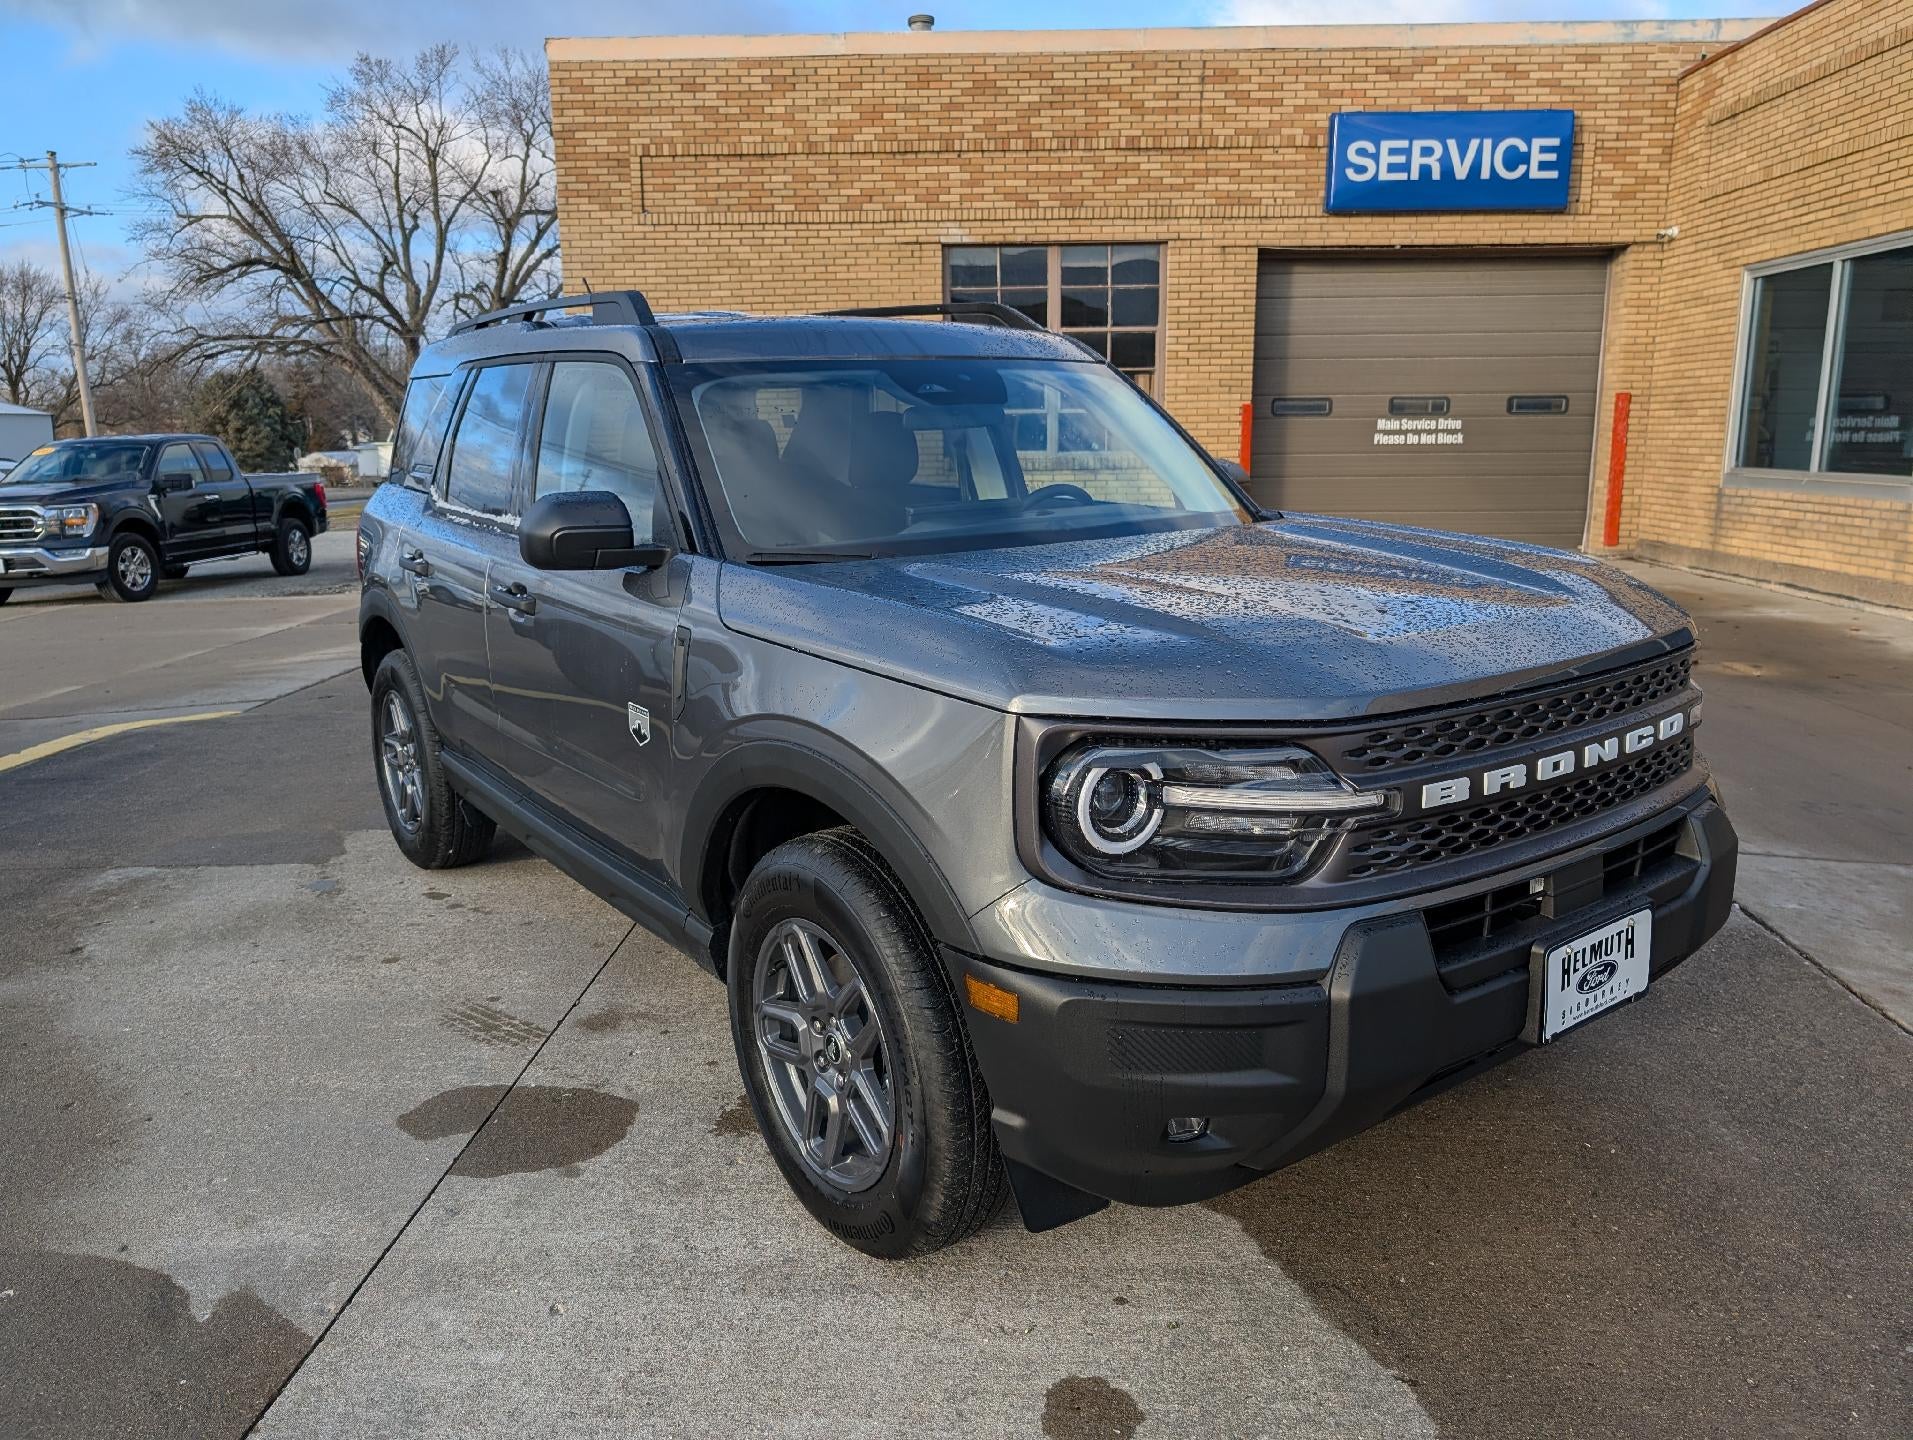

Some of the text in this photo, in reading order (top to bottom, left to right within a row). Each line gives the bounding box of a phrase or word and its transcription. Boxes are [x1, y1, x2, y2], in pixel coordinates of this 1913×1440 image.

[1345, 137, 1560, 182] SERVICE
[1374, 432, 1464, 445] Please Do Not Block
[1377, 418, 1462, 430] Main Service Drive
[1422, 712, 1684, 809] BRONCO
[1561, 926, 1635, 992] HELMUTH
[1583, 964, 1612, 991] Ford
